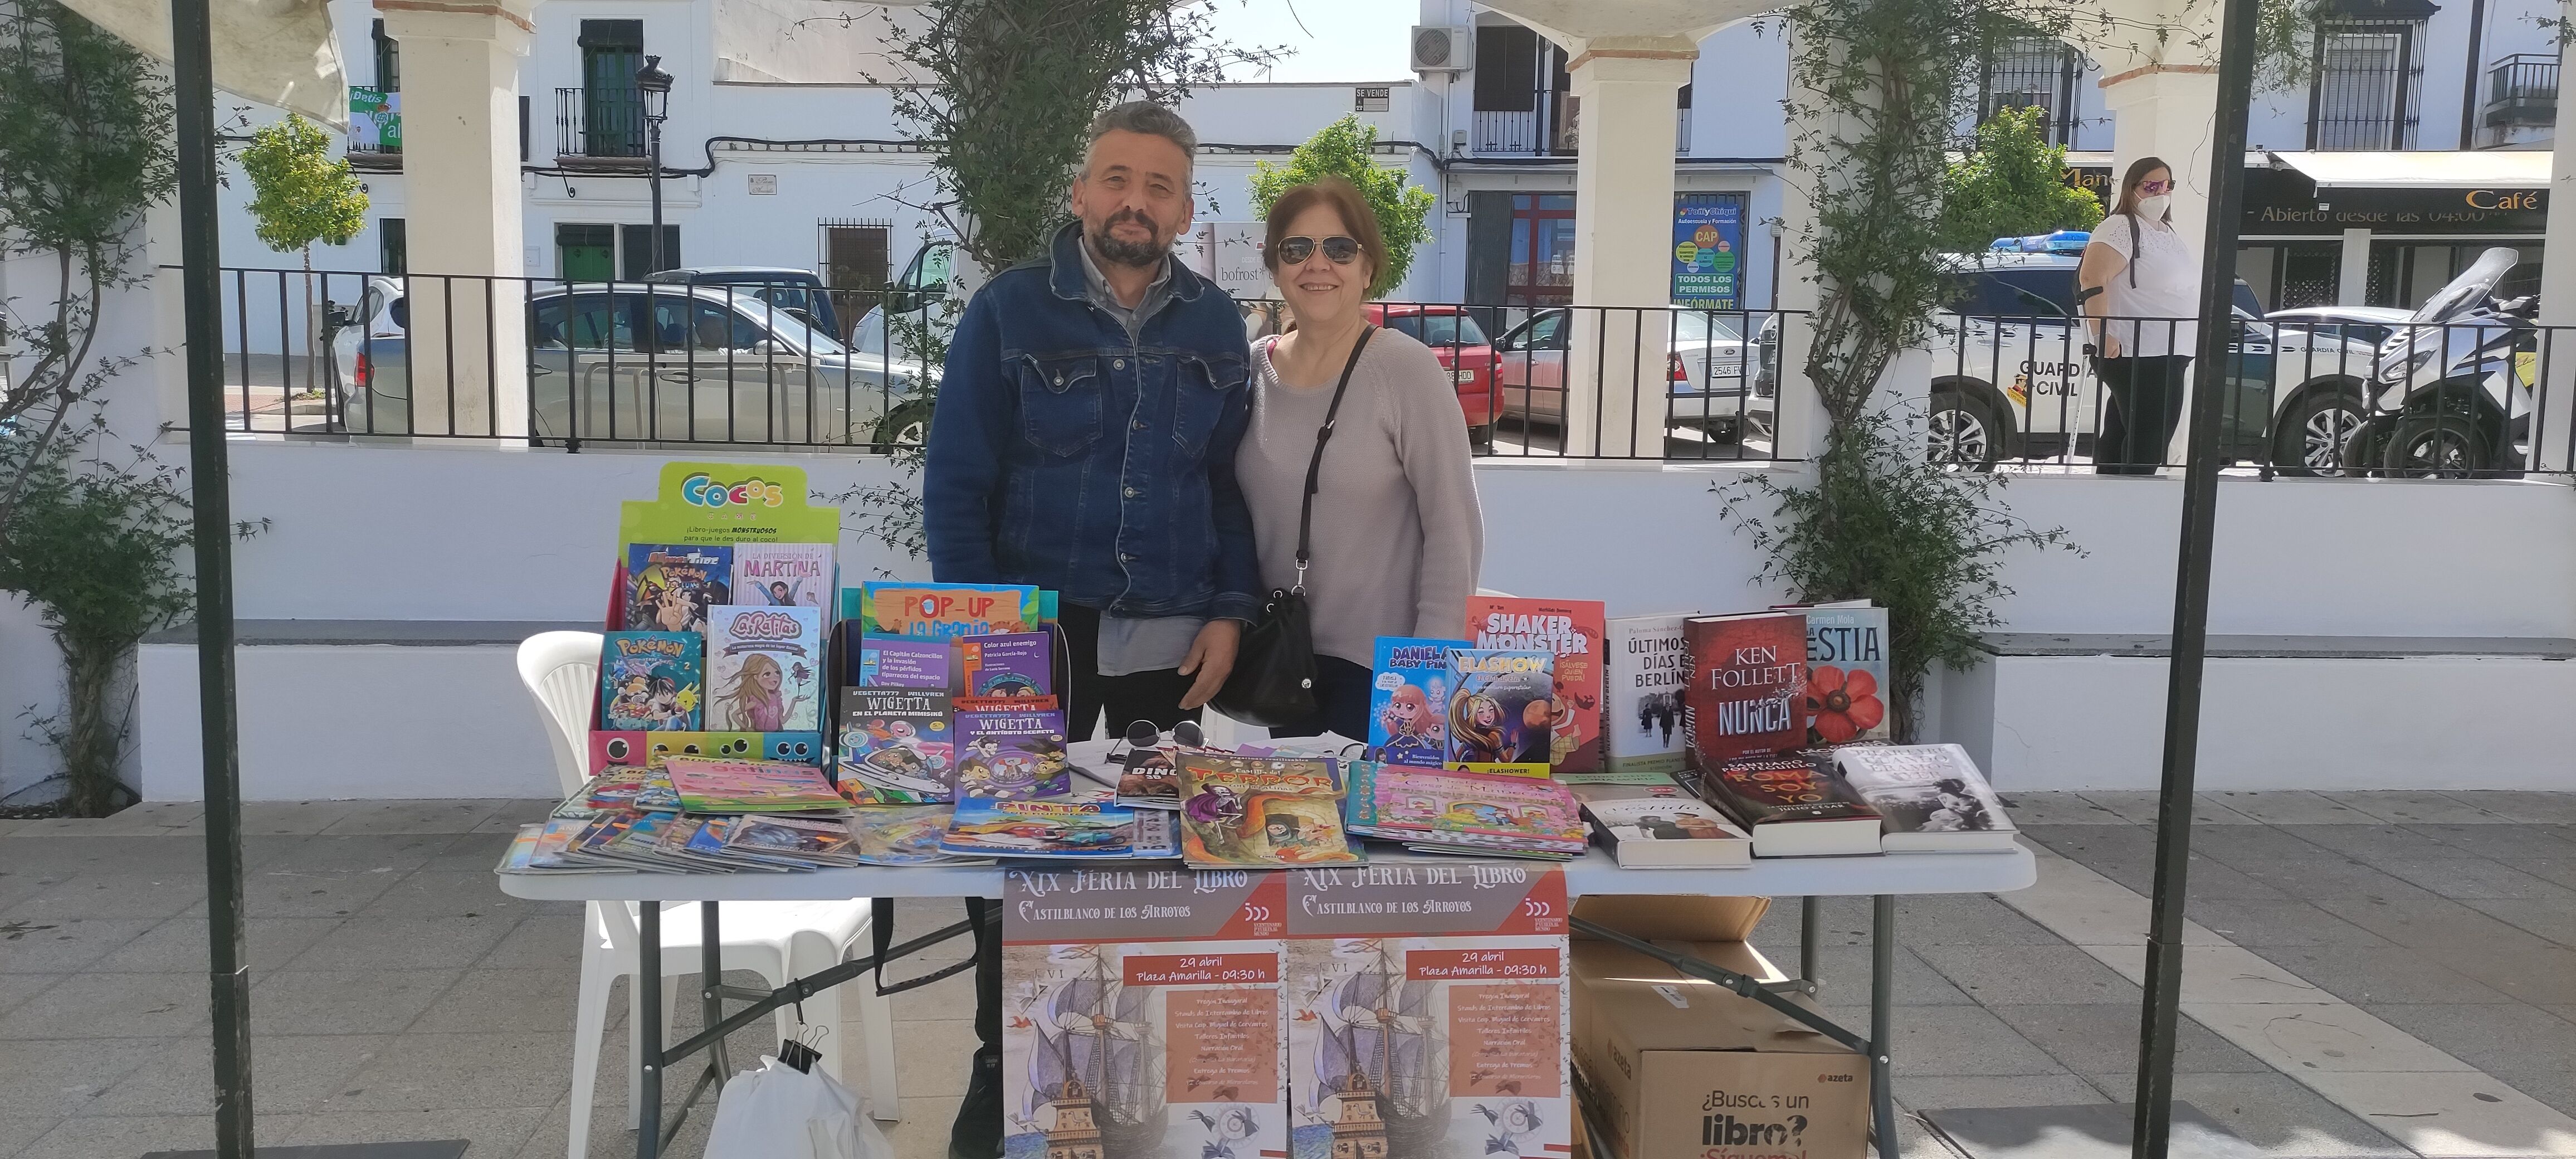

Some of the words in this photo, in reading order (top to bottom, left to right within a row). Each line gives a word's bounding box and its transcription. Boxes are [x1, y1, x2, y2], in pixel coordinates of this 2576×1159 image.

[1367, 89, 1388, 98] VENDE
[2466, 189, 2538, 210] Café
[2260, 206, 2327, 222] Abierto
[1696, 231, 1718, 242] CAP
[1674, 296, 1734, 309] INFÓRMATE
[1714, 366, 1731, 376] 2546
[2020, 360, 2097, 378] GUARDA
[744, 559, 820, 577] MARTINA
[751, 613, 796, 635] Ratitas
[1487, 613, 1572, 635] SHAKER
[1806, 615, 1834, 625] Carmen
[1837, 615, 1854, 624] Mola
[1477, 629, 1589, 655] MONSTER
[1628, 637, 1685, 654] ÚLTIMOS
[1389, 659, 1422, 668] BABY
[1644, 653, 1675, 670] DÍAS
[1735, 645, 1777, 666] KEN
[1458, 656, 1547, 674] ELASHOW
[1636, 669, 1685, 687] BERLÍN
[1711, 662, 1801, 690] FOLLETT
[867, 696, 931, 710] WIGETTA
[979, 718, 1043, 730] WIGETTA
[1719, 696, 1792, 736] NUNCA
[1721, 763, 1817, 772] POSTEGUILLO
[1185, 766, 1333, 787] TERROR
[1732, 771, 1828, 782] ROMA
[1760, 782, 1817, 792] SOY
[994, 801, 1101, 813] PINTA
[1777, 794, 1822, 803] YO
[1009, 870, 1061, 897] XIX
[1070, 868, 1137, 894] FERIA
[1146, 871, 1182, 890] DEL
[1193, 870, 1248, 894] LIBRO
[1303, 868, 1343, 892] XIX
[1352, 865, 1418, 888] FERIA
[1427, 867, 1462, 885] DEL
[1468, 865, 1526, 889] LIBRO
[1018, 900, 1101, 923] CASTILBLANCO
[1104, 908, 1116, 919] DE
[1120, 907, 1137, 919] LOS
[1140, 904, 1191, 920] ARROYOS
[1302, 895, 1383, 917] CASTILBLANCO
[1387, 902, 1398, 914] DE
[1402, 900, 1419, 913] LOS
[1422, 898, 1472, 914] ARROYOS
[1179, 957, 1196, 968] 29
[1199, 956, 1222, 967] abril
[1461, 952, 1479, 963] 29
[1481, 951, 1504, 962] abril
[1136, 972, 1166, 982] Plaza
[1168, 970, 1212, 982] Amarilla
[1222, 969, 1255, 981] 09:30
[1257, 968, 1265, 979] h
[1419, 966, 1448, 977] Plaza
[1451, 965, 1494, 976] Amarilla
[1504, 964, 1537, 975] 09:30
[1539, 963, 1547, 975] h
[1210, 1021, 1228, 1030] Miguel
[1702, 1090, 1780, 1111] ¿Buscs
[1786, 1095, 1809, 1109] un
[1702, 1114, 1808, 1147] libro?
